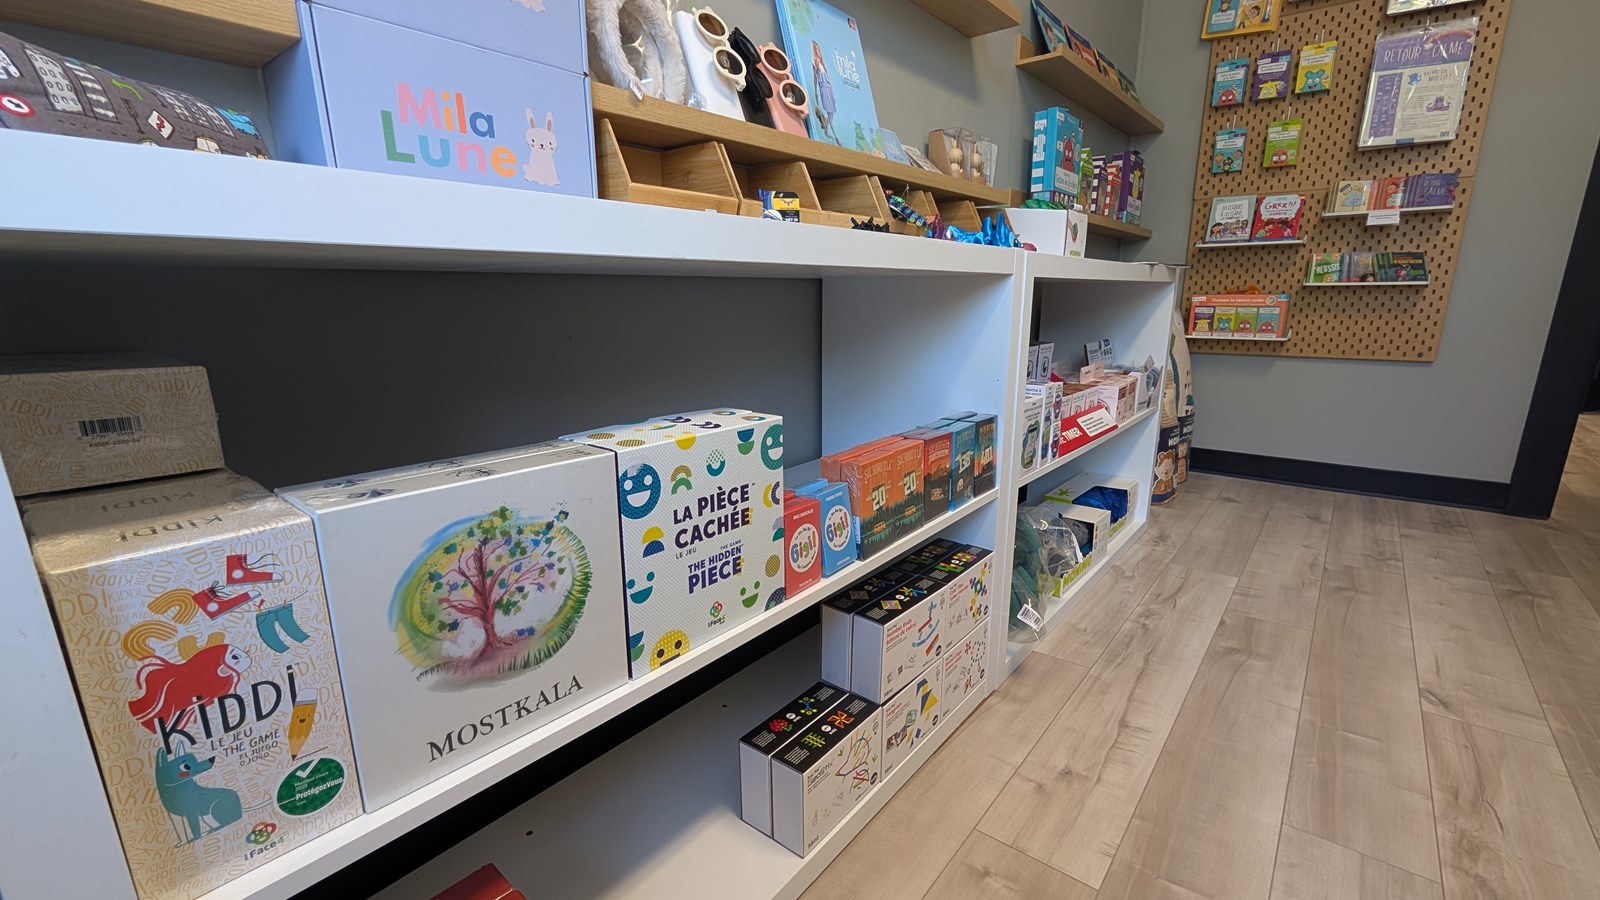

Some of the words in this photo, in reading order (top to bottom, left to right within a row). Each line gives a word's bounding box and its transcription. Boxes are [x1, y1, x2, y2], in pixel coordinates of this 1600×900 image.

[396, 81, 496, 138] Mila
[380, 109, 518, 178] Lune
[872, 485, 886, 511] 20
[904, 472, 916, 496] 20
[673, 505, 693, 525] LA
[697, 483, 750, 517] PIÈCE
[675, 505, 750, 549] CACHÉE
[675, 551, 684, 560] LE
[685, 547, 697, 557] JEU
[729, 539, 742, 548] GAME
[688, 559, 706, 574] THE
[708, 545, 742, 567] HIDDEN
[688, 555, 742, 595] PIECE
[425, 674, 584, 763] MOSTKALA
[210, 737, 226, 751] LE
[231, 727, 253, 744] JEU
[222, 742, 246, 757] THE
[249, 729, 281, 748] GAME
